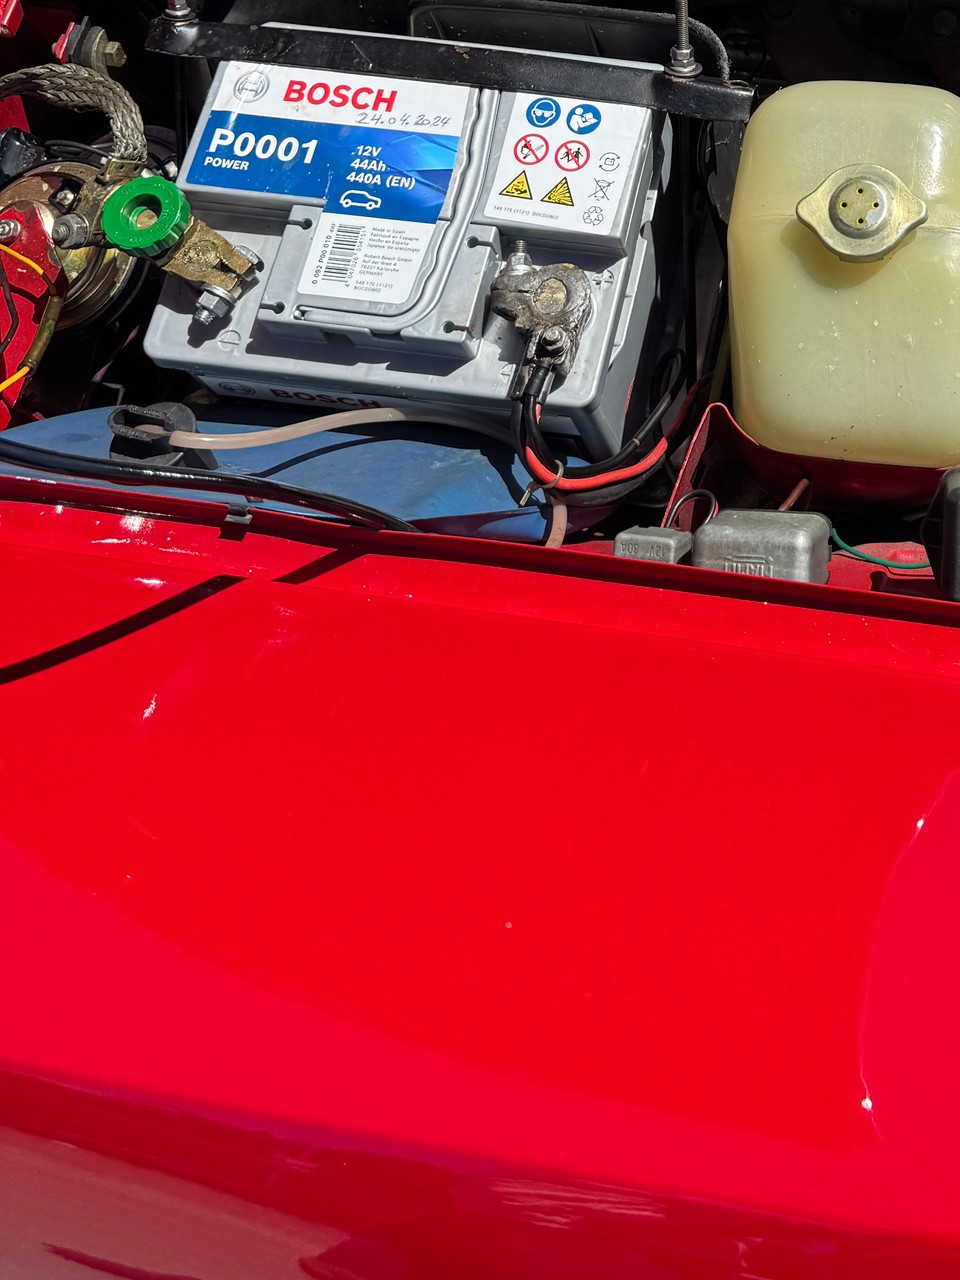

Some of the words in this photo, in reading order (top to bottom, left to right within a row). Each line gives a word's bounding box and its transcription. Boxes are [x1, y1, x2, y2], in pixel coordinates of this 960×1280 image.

[283, 79, 398, 113] BOSCH
[208, 128, 318, 164] P0001
[356, 145, 382, 157] 12V
[204, 156, 249, 171] POWER
[350, 158, 387, 172] 44Ah
[346, 171, 381, 186] 440A
[386, 175, 416, 190] (EN)
[313, 265, 323, 278] 092
[318, 250, 328, 263] P00
[323, 235, 332, 248] 010
[269, 388, 382, 409] BOSCH
[647, 545, 666, 558] 12V
